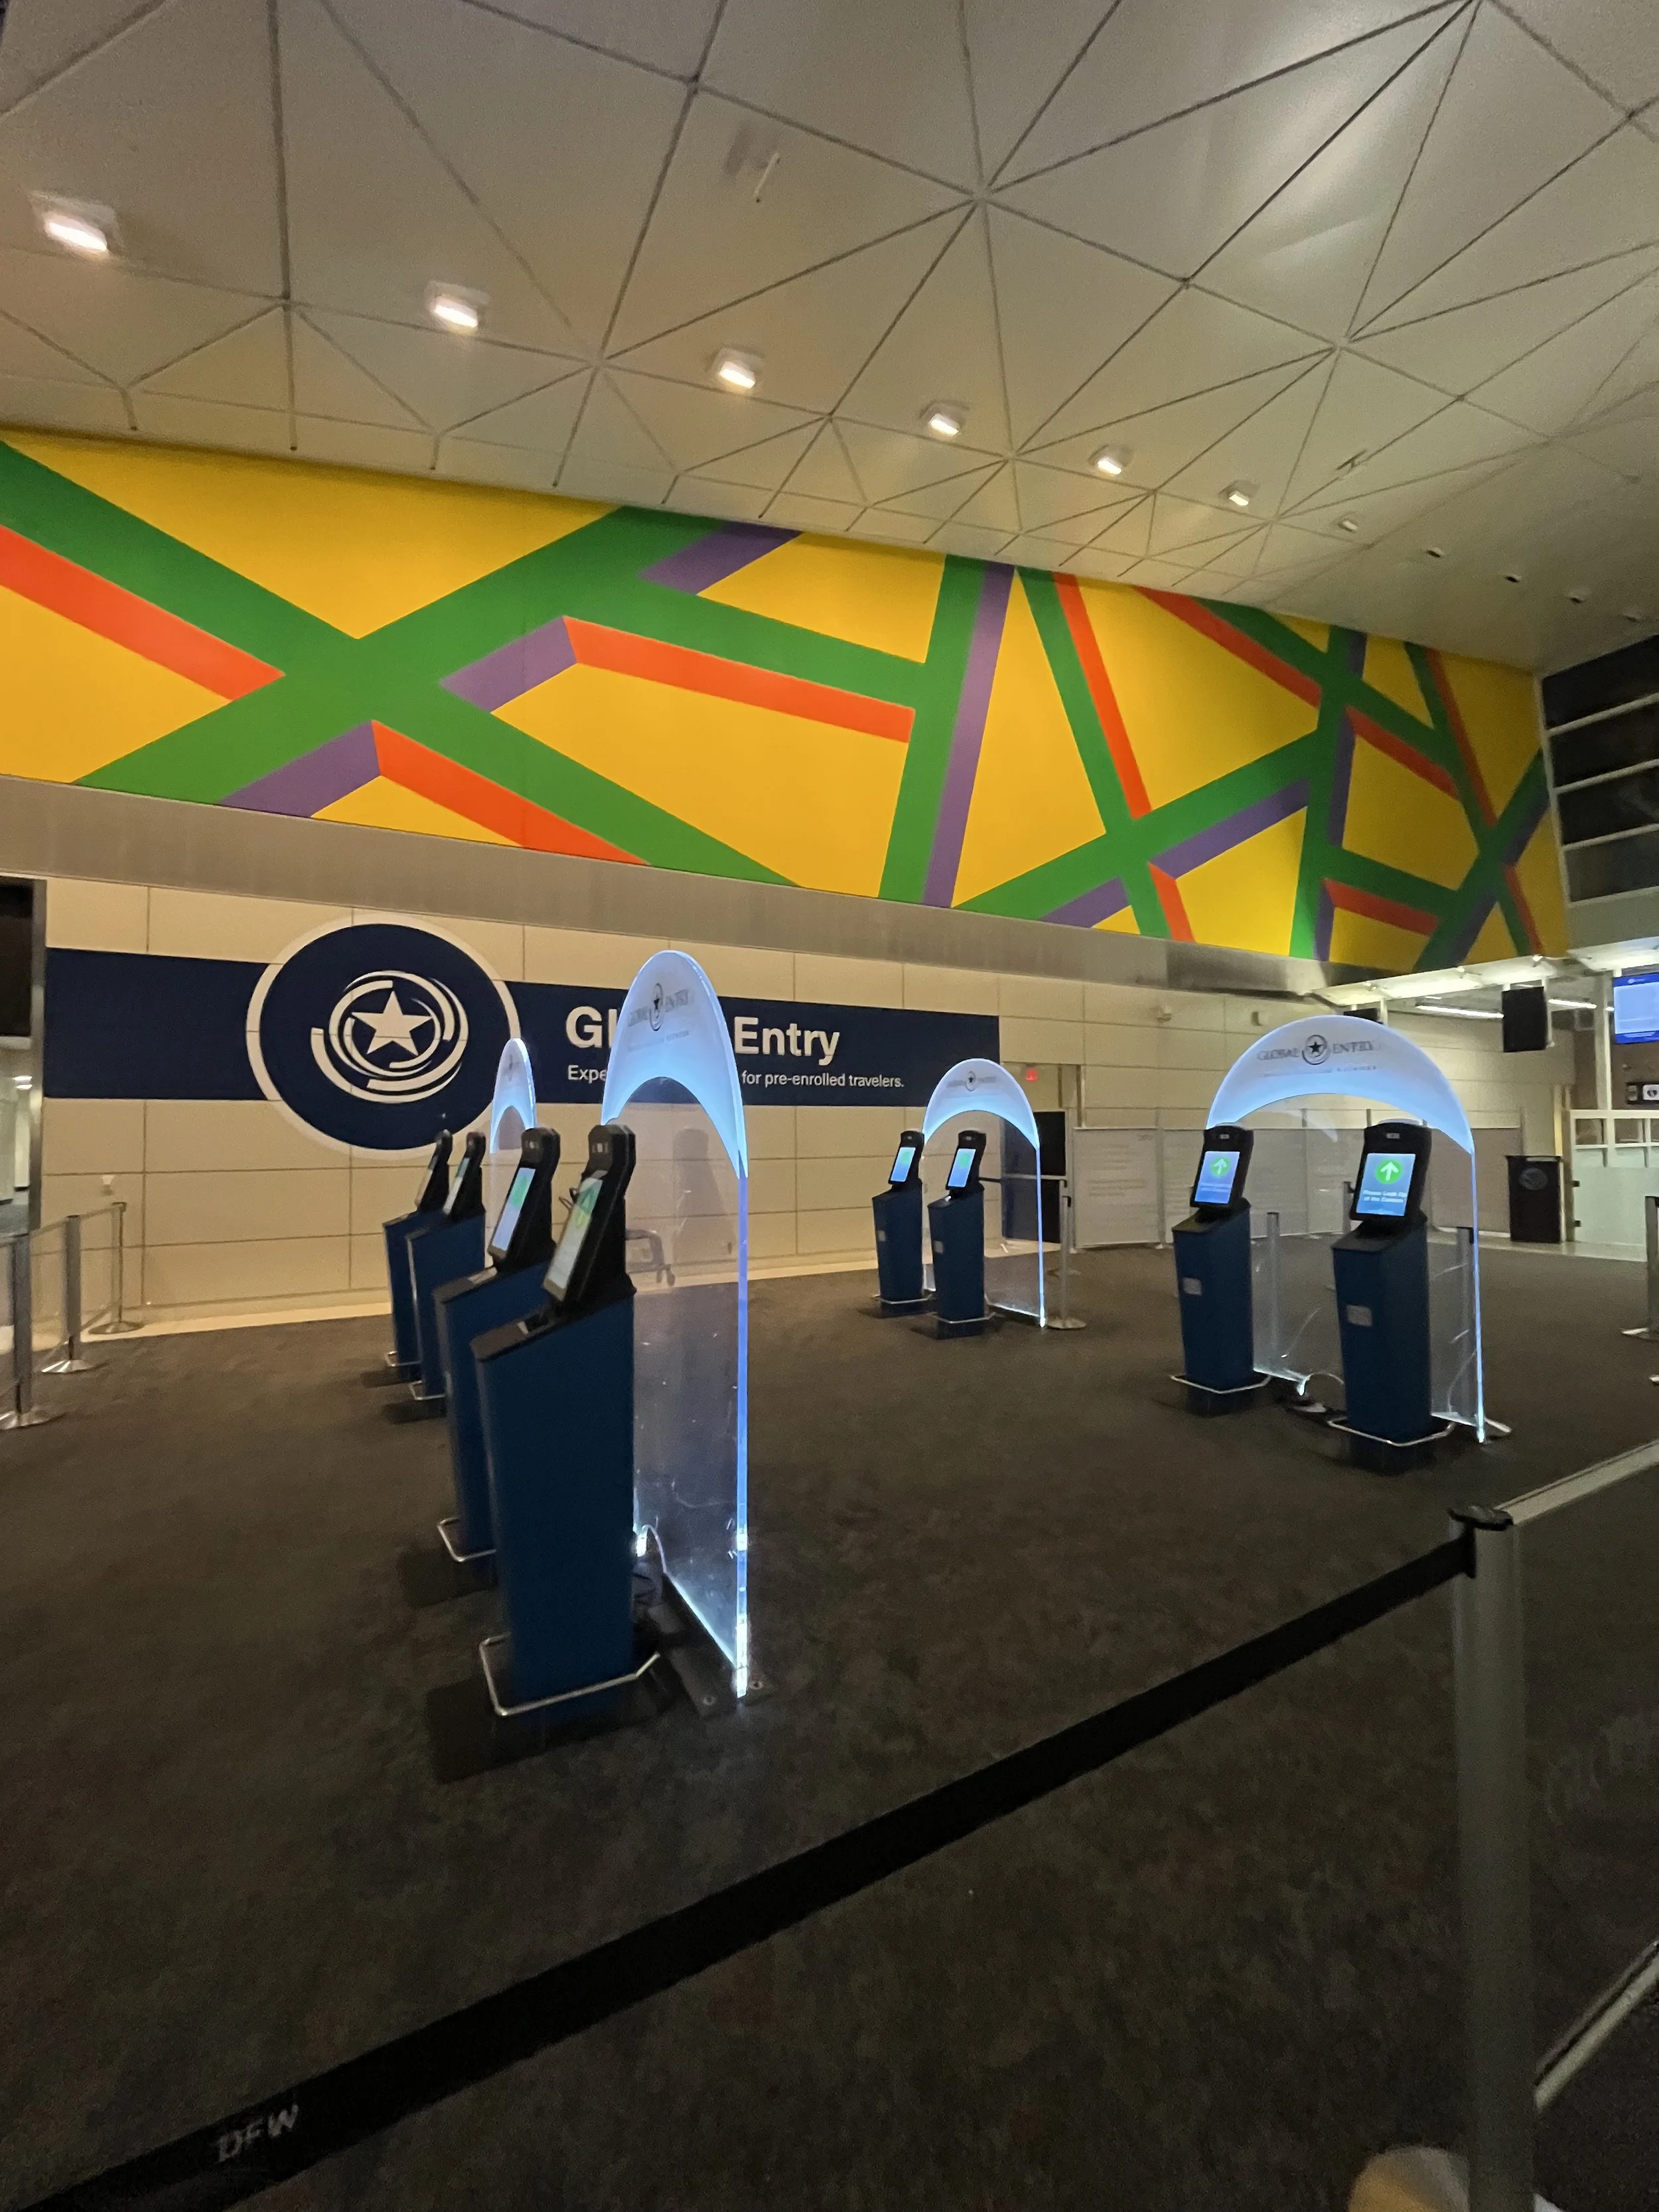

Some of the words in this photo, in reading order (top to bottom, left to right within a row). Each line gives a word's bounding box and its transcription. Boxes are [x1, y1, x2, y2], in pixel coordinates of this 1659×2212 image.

[734, 1016, 840, 1066] Entry
[741, 1070, 761, 1084] for
[764, 1072, 845, 1088] pre-enrolled
[849, 1074, 904, 1088] travelers.
[219, 2103, 299, 2162] DFW
